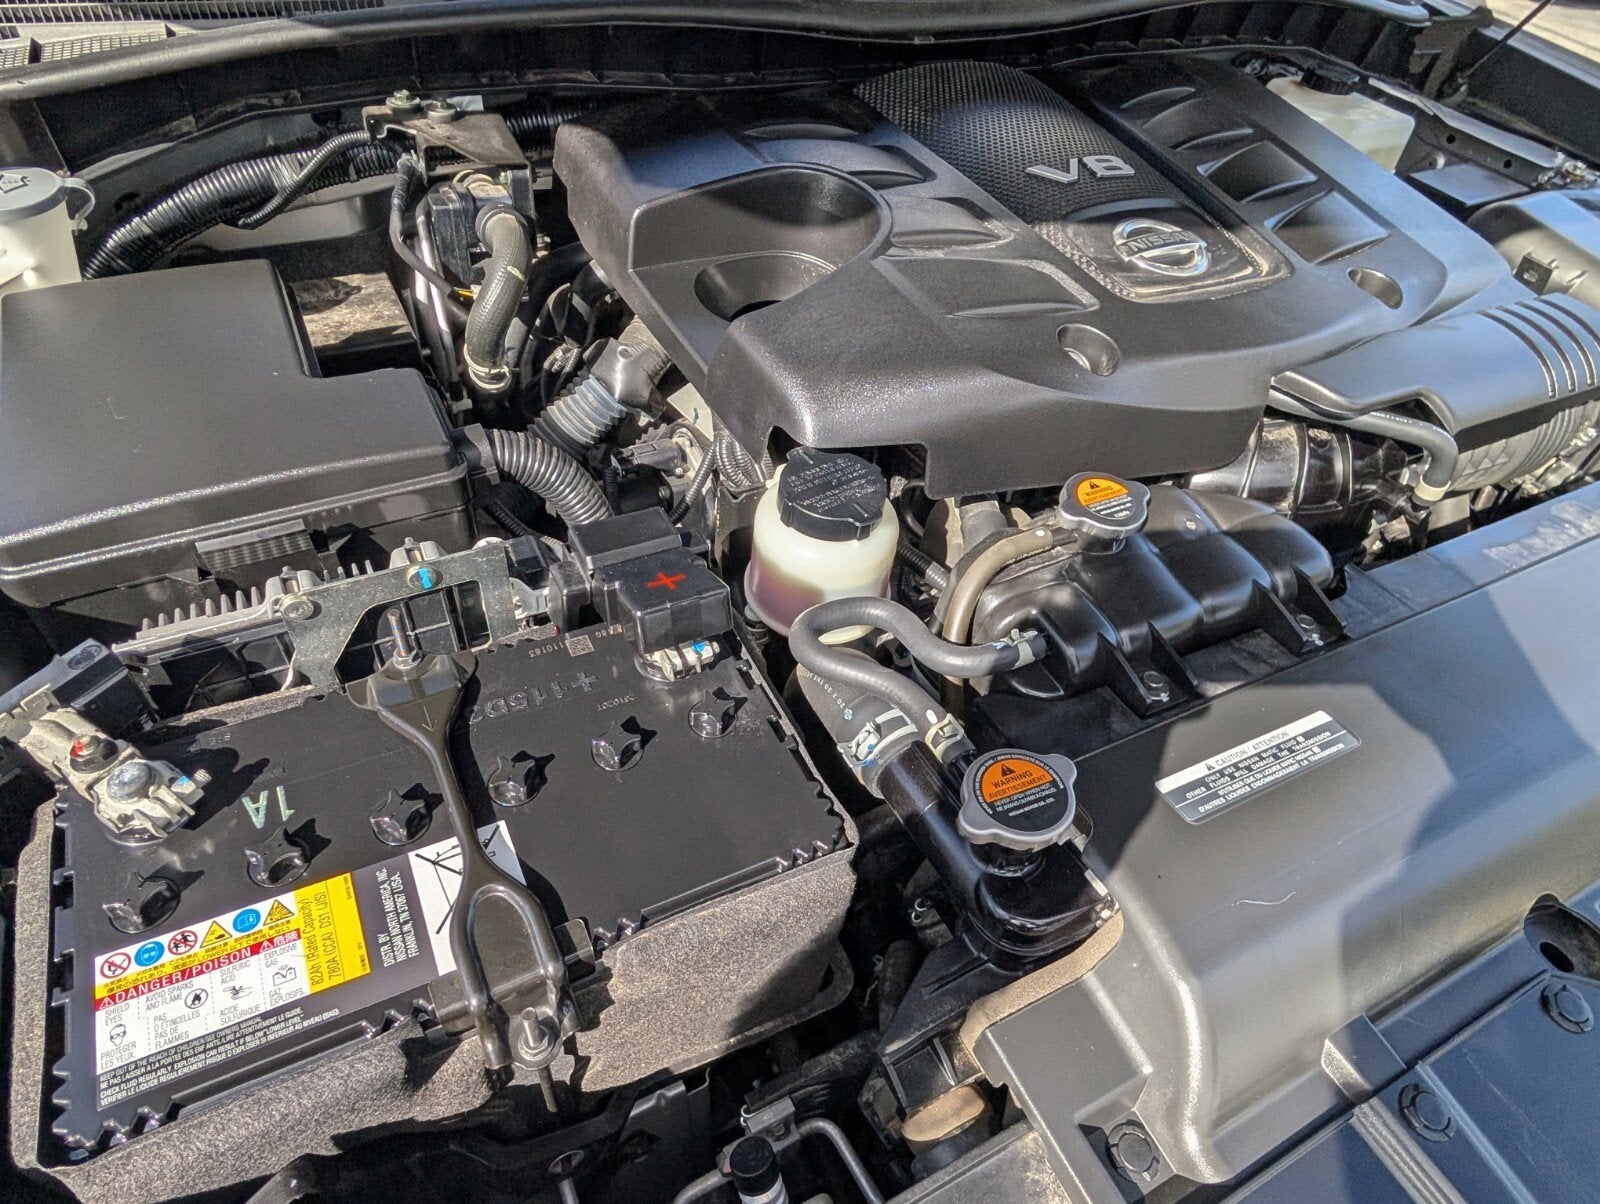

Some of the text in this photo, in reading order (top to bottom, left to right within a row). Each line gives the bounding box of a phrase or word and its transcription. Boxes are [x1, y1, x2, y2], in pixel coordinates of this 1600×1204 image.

[1025, 155, 1136, 184] V8
[1130, 230, 1197, 252] NISSAN
[1215, 749, 1248, 766] CAUTION
[1251, 731, 1289, 750] ATTENTION
[1185, 786, 1206, 798] OTHER
[1209, 775, 1230, 788] FLUIDS
[1233, 768, 1248, 777] WILL
[1250, 756, 1275, 769] DAMAGE
[1291, 731, 1331, 750] TRANSMISSION
[1204, 772, 1221, 782] ONLY
[1223, 766, 1236, 774] USE
[1237, 755, 1260, 767] NISSAN
[1260, 747, 1279, 757] MATIC
[1279, 739, 1297, 749] FLUID
[1225, 785, 1250, 799] LIQUIDES
[1307, 743, 1344, 761] TRANSMISSION
[988, 774, 1047, 800] AVERTISSEMENT
[992, 770, 1033, 788] WARNING
[242, 786, 296, 829] 1A
[376, 867, 406, 962] NISSAN NORTH AMERICA, INC.
[389, 871, 421, 957] FRANKLIN, TN 37067 USA.
[298, 897, 323, 985] 82Ah (Rated Capacity)
[314, 891, 340, 979] 780A (CCA) D31 (JIS)
[264, 943, 296, 960] EXPLOSIVE
[378, 932, 394, 966] DISTR. BY
[220, 960, 250, 976] SULFURIC
[265, 958, 277, 967] GAS
[116, 946, 251, 1003] DANGER/POISON
[221, 973, 235, 984] ACID
[145, 980, 193, 1003] AVOID SPARKS
[146, 992, 182, 1011] AND FLAME
[269, 987, 281, 997] GAZ
[105, 1003, 128, 1017] SHIELD
[105, 1013, 121, 1026] EYES
[154, 1012, 166, 1023] PAS
[220, 1004, 238, 1017] ACIDE
[220, 1004, 260, 1025] SULFURIQUE
[155, 1026, 177, 1040] PAS DE
[155, 1030, 188, 1049] FLAMMES
[100, 1080, 107, 1089] NE
[109, 1075, 120, 1085] PAS
[122, 1066, 145, 1080] LAISSER
[152, 1061, 158, 1069] LA
[182, 1048, 193, 1057] DES
[235, 1016, 277, 1037] ATTENTIVEMENT
[100, 1090, 126, 1106] VERIFIER
[128, 1087, 134, 1095] LE
[136, 1078, 158, 1092] LIQUIDE
[206, 1051, 226, 1064] RISQUE
[267, 1025, 294, 1040] INFERIEUR
[294, 1022, 302, 1030] AU
[303, 1014, 321, 1026] NIVEAU
[101, 1041, 135, 1060] PROTEGER
[101, 1051, 133, 1070] LES YEUX
[100, 1070, 113, 1081] KEEP
[116, 1065, 127, 1074] OUT
[128, 1062, 135, 1070] OF
[137, 1058, 147, 1066] THE
[149, 1051, 167, 1062] REACH
[168, 1047, 175, 1055] OF
[100, 1085, 119, 1098] CHECK
[120, 1078, 137, 1090] FLUID
[174, 1052, 204, 1069] EXPLOSION
[205, 1048, 216, 1057] CAN
[217, 1040, 238, 1052] RESULT
